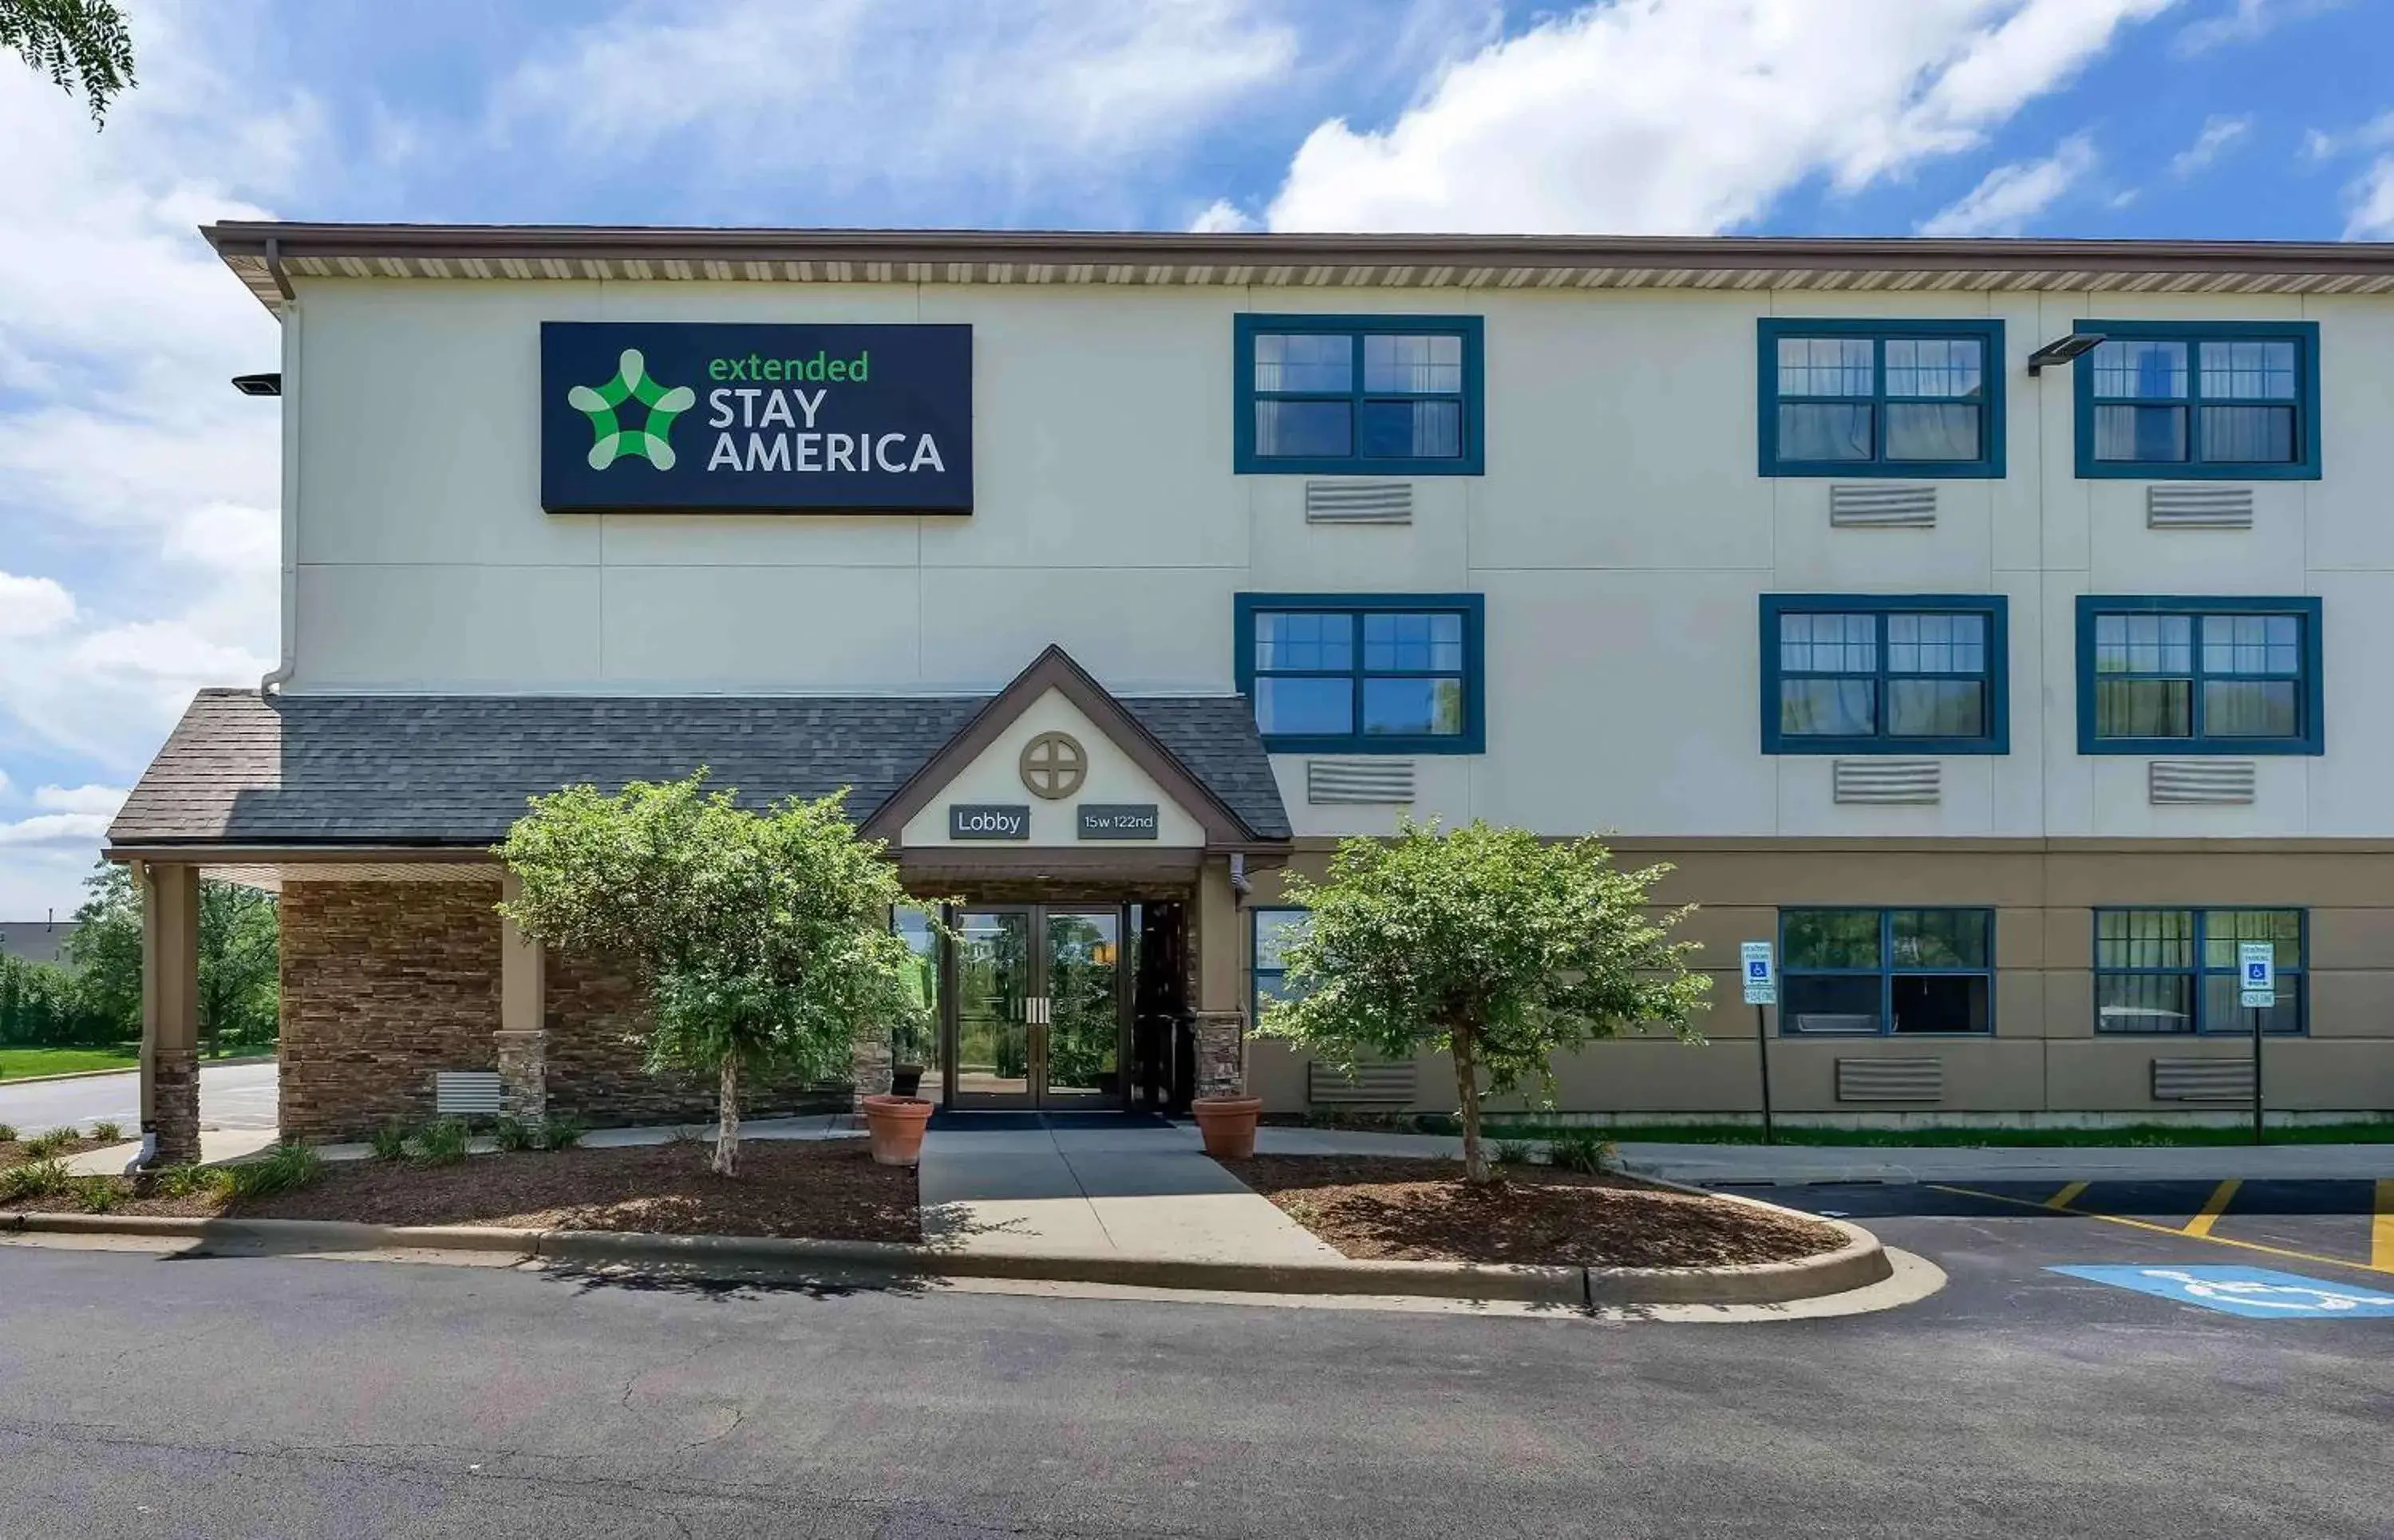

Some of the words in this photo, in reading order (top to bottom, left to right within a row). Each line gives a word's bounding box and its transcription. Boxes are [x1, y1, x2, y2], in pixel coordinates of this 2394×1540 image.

[709, 350, 868, 382] extended
[708, 389, 828, 428] STAY
[707, 432, 946, 472] AMERICA
[958, 811, 1021, 834] Lobby
[1085, 815, 1110, 827] 15w
[1113, 814, 1154, 827] 122nd
